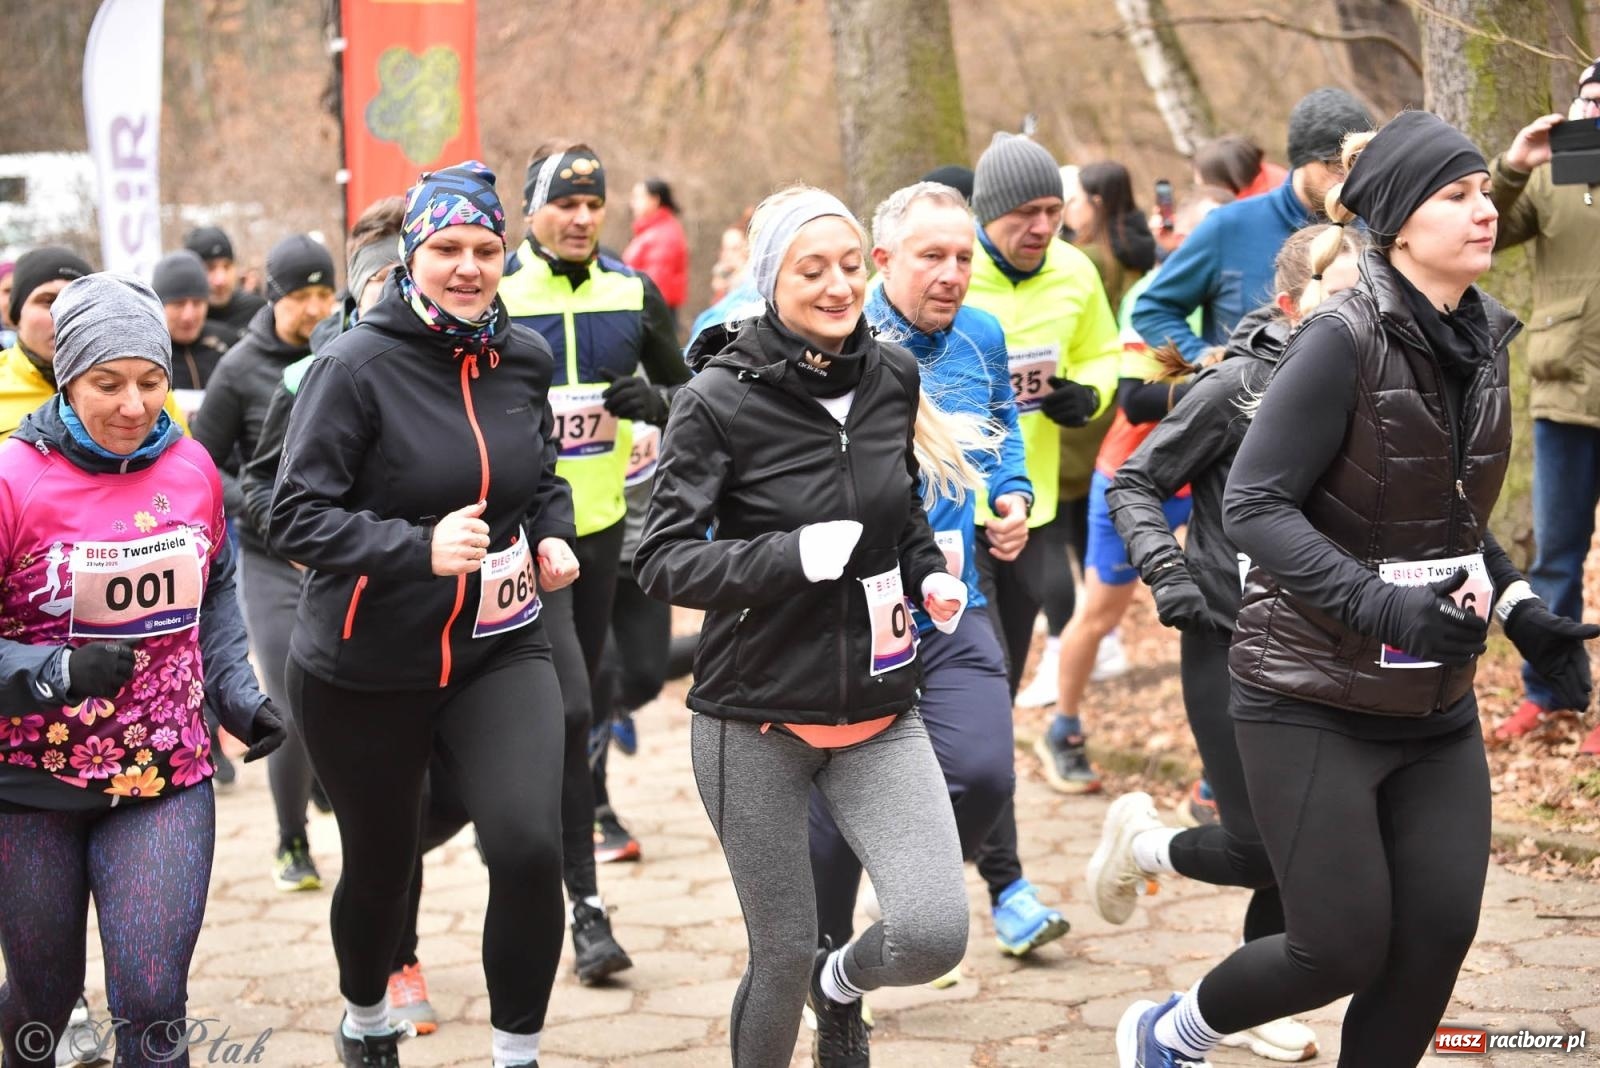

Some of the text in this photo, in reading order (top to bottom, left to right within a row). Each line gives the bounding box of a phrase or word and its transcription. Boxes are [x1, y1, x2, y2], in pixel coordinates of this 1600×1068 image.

[1008, 349, 1052, 361] wardziela
[797, 361, 828, 377] adidas
[1010, 369, 1042, 396] 35
[556, 413, 602, 439] 137
[86, 537, 186, 559] BIEG Twardziela
[491, 554, 511, 568] BIEG
[1393, 568, 1424, 580] BIEG
[105, 569, 175, 611] 001
[497, 562, 534, 609] 065
[153, 616, 182, 627] Racibórz
